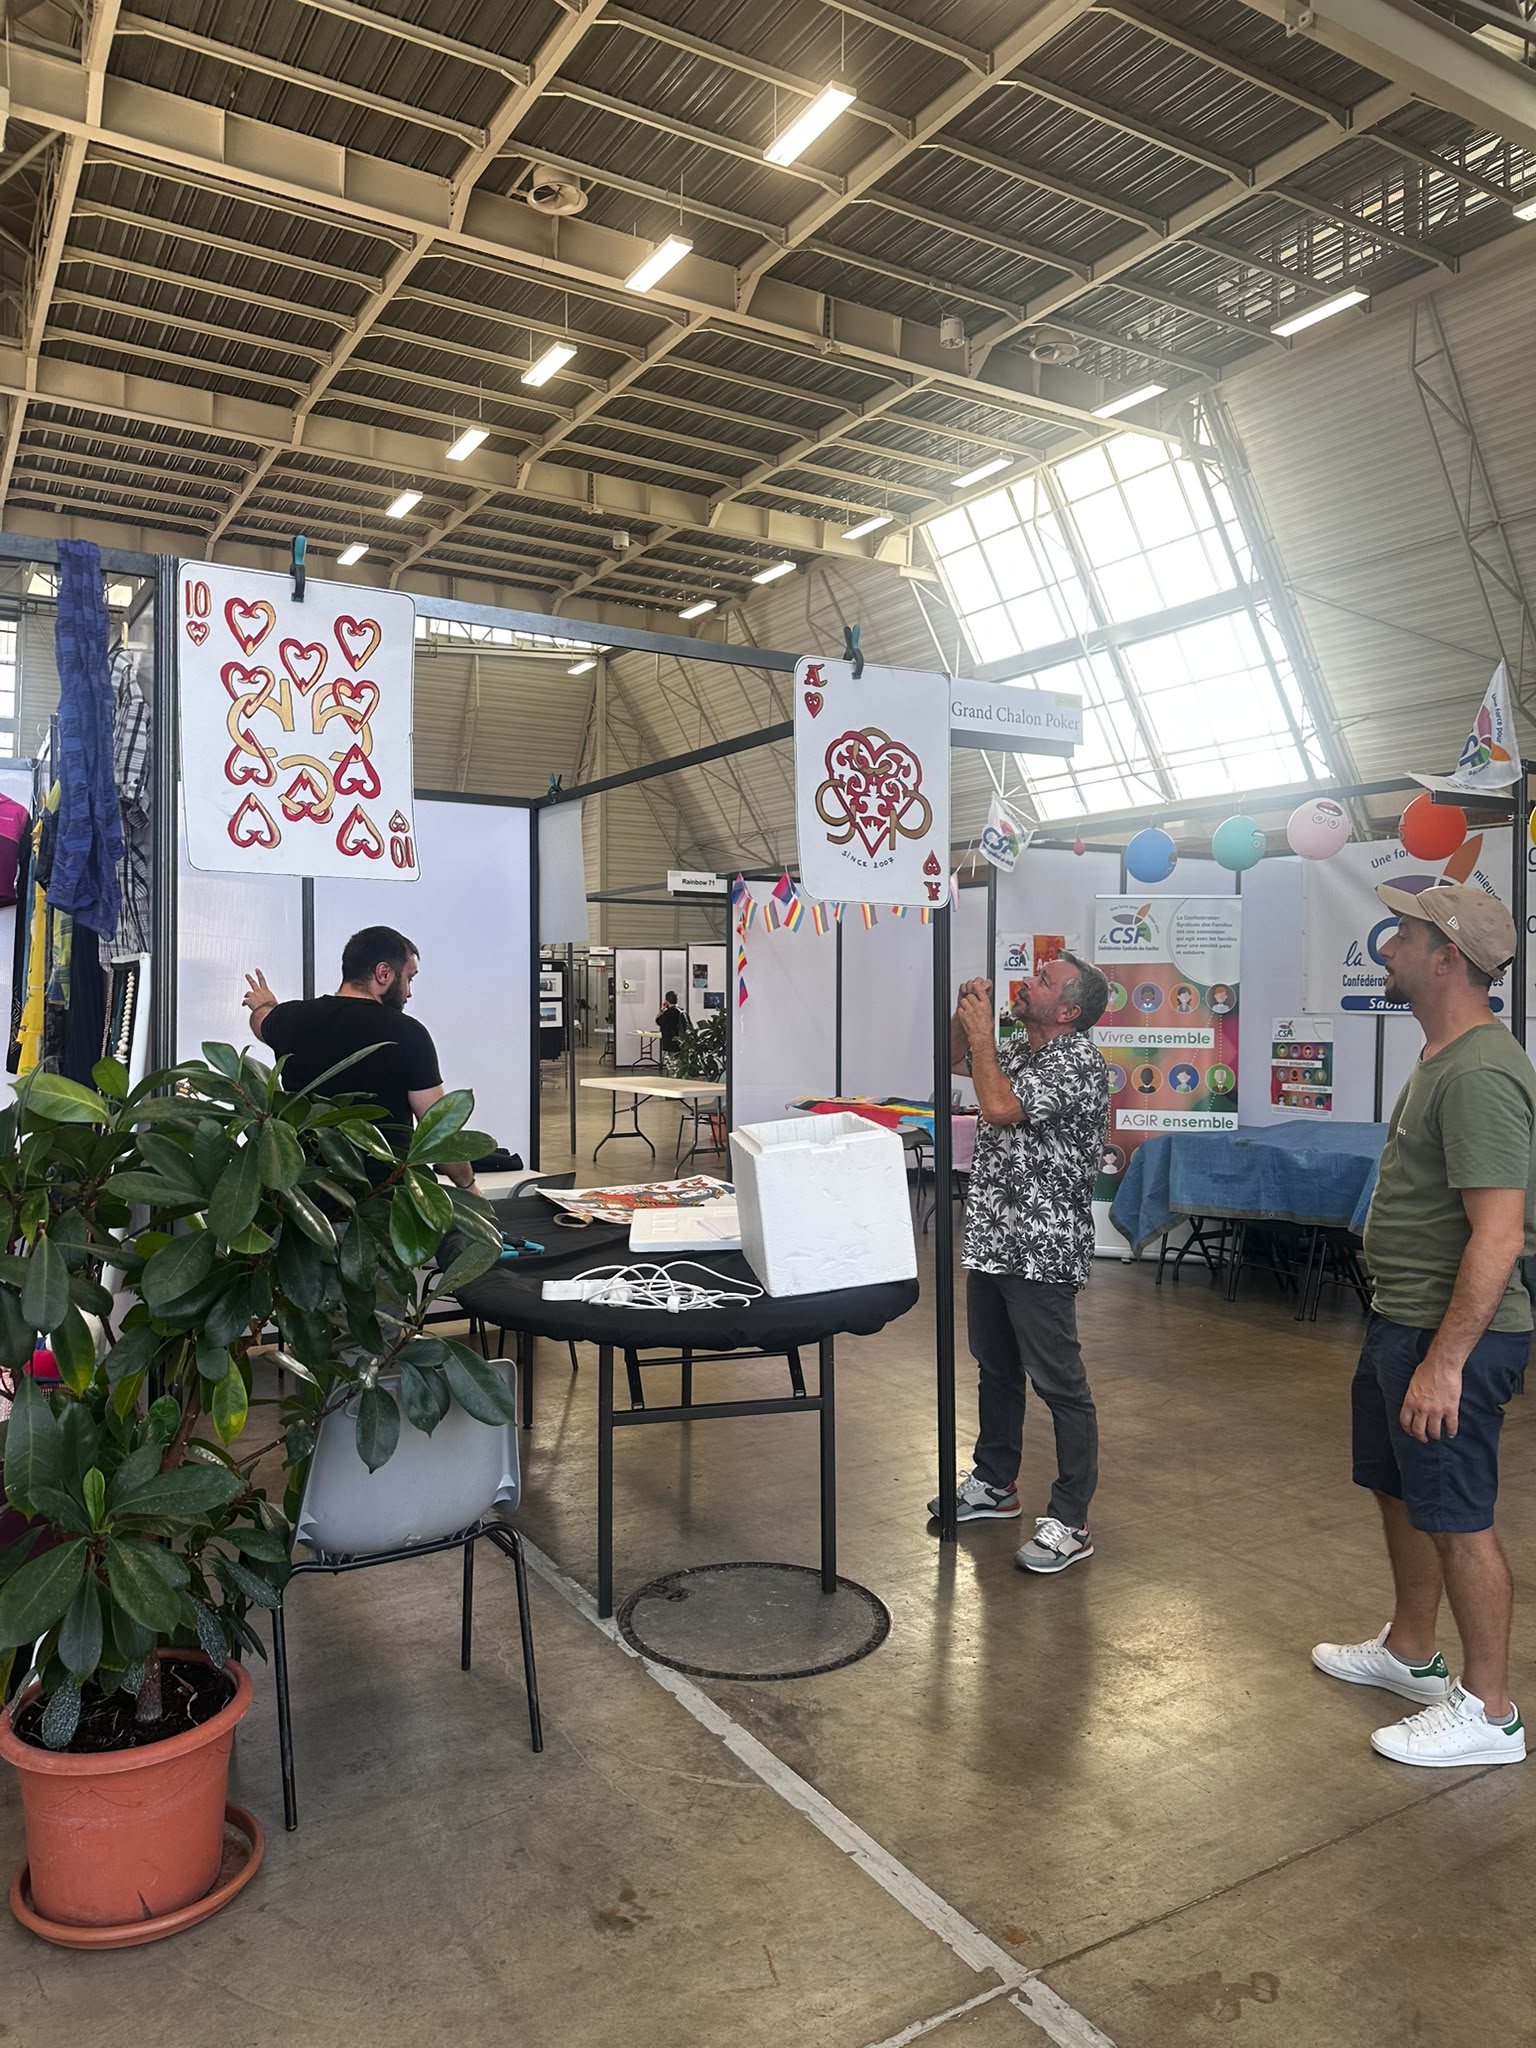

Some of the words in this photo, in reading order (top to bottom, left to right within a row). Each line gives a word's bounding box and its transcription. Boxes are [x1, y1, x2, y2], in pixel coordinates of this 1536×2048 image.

[185, 580, 211, 617] 10
[951, 701, 993, 721] Grand
[996, 707, 1042, 726] Chalon
[1045, 713, 1079, 731] Poker
[1371, 855, 1392, 869] Une
[681, 878, 707, 886] Rainbow
[1109, 927, 1147, 944] CSF
[1342, 940, 1366, 967] la
[1342, 974, 1385, 987] Confédéra
[1098, 1030, 1134, 1045] Vivre
[1138, 1031, 1211, 1045] ensemble
[1121, 1113, 1158, 1127] AGIR
[1162, 1116, 1234, 1130] ensemble
